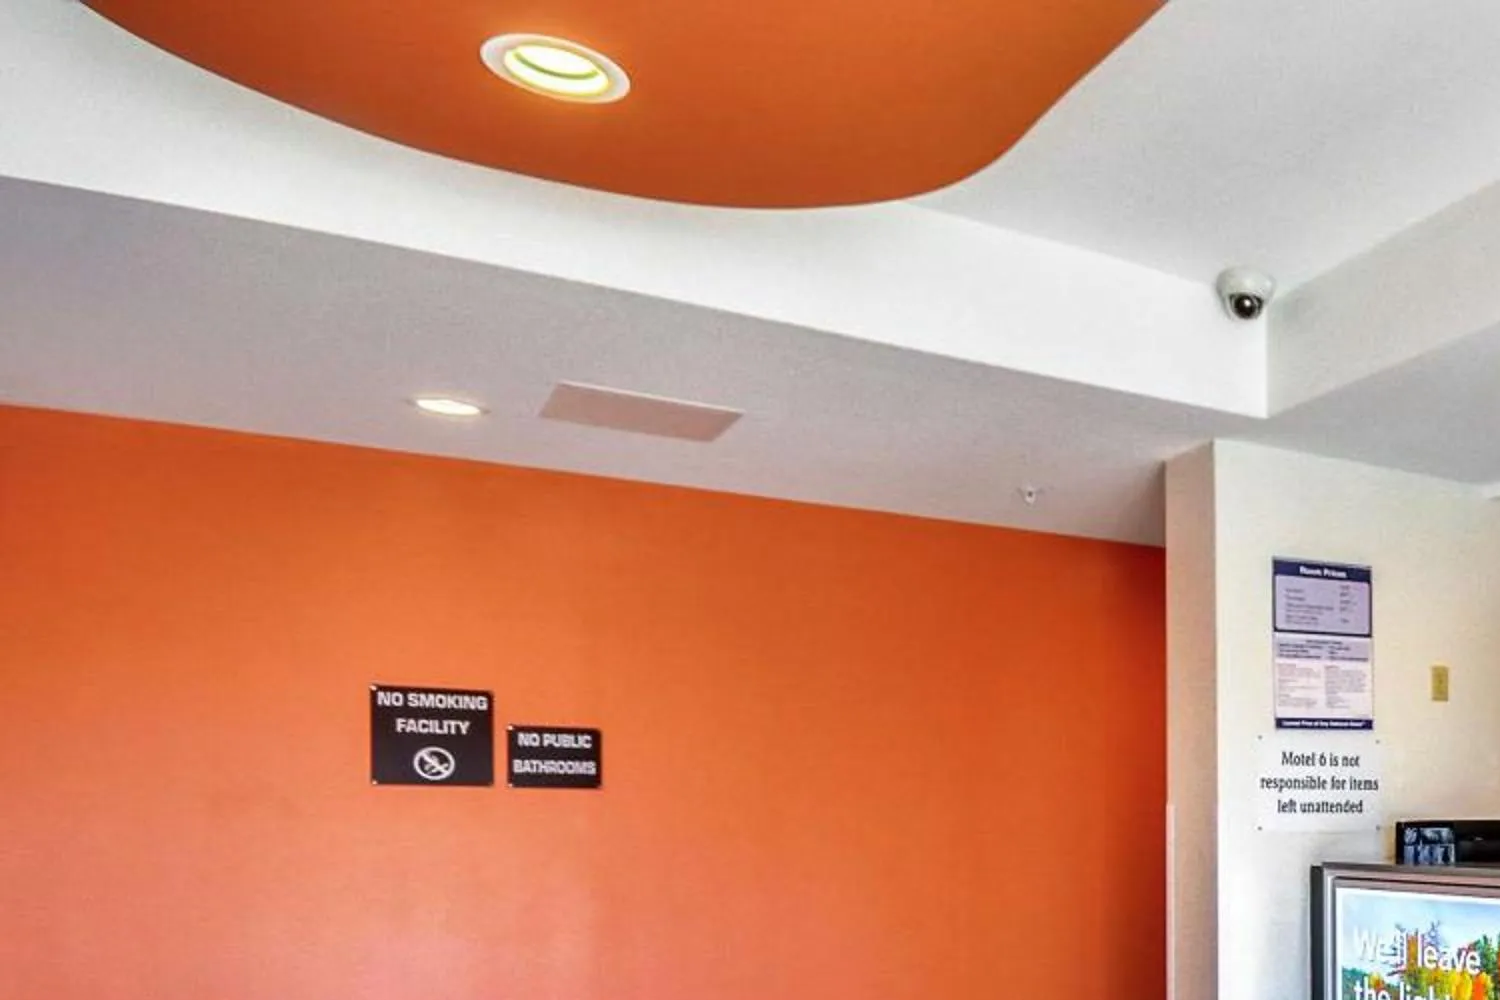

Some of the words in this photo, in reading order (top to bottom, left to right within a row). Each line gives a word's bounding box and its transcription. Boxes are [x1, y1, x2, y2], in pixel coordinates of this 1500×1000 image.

[377, 691, 403, 707] NO
[407, 693, 489, 711] SMOKING
[396, 718, 470, 735] FACILITY
[518, 733, 539, 747] NO
[543, 733, 593, 749] PUBLIC
[513, 759, 596, 775] BATHROOMS
[1281, 751, 1316, 767] Motel
[1319, 752, 1327, 767] 6
[1330, 752, 1338, 767] is
[1342, 755, 1360, 767] not
[1260, 775, 1328, 795] responsible
[1330, 776, 1347, 791] for
[1349, 777, 1380, 792] items
[1277, 798, 1298, 814] left
[1299, 799, 1364, 815] unattended
[1416, 932, 1481, 976] leave
